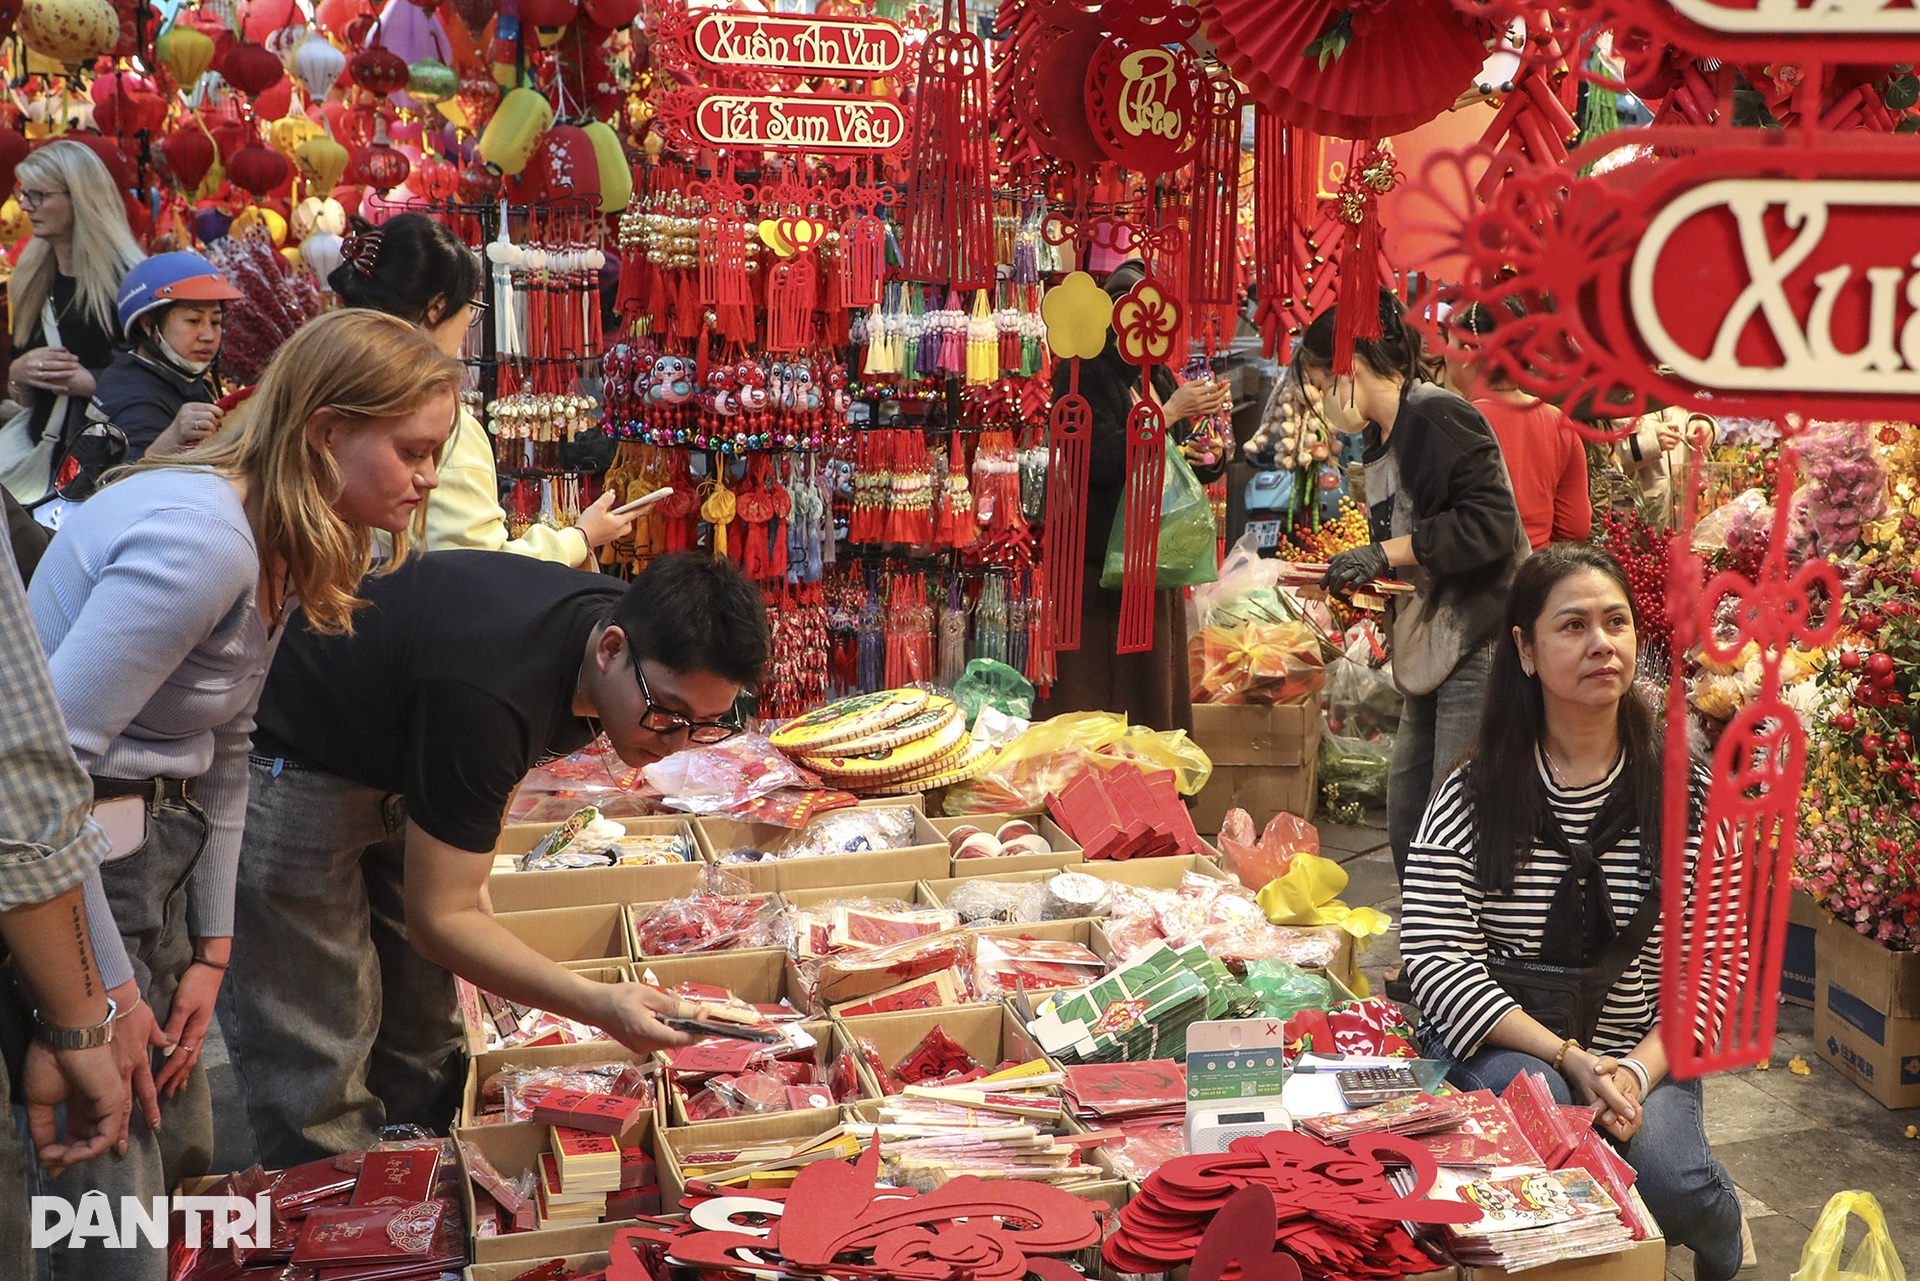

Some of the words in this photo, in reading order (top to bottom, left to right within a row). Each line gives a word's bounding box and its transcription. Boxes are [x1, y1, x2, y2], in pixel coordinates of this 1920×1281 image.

[713, 17, 788, 62] Xuân
[793, 25, 839, 65] An
[842, 27, 886, 69] Vui
[713, 101, 759, 140] Tết
[766, 101, 829, 142] Sum
[834, 105, 890, 145] Vầy
